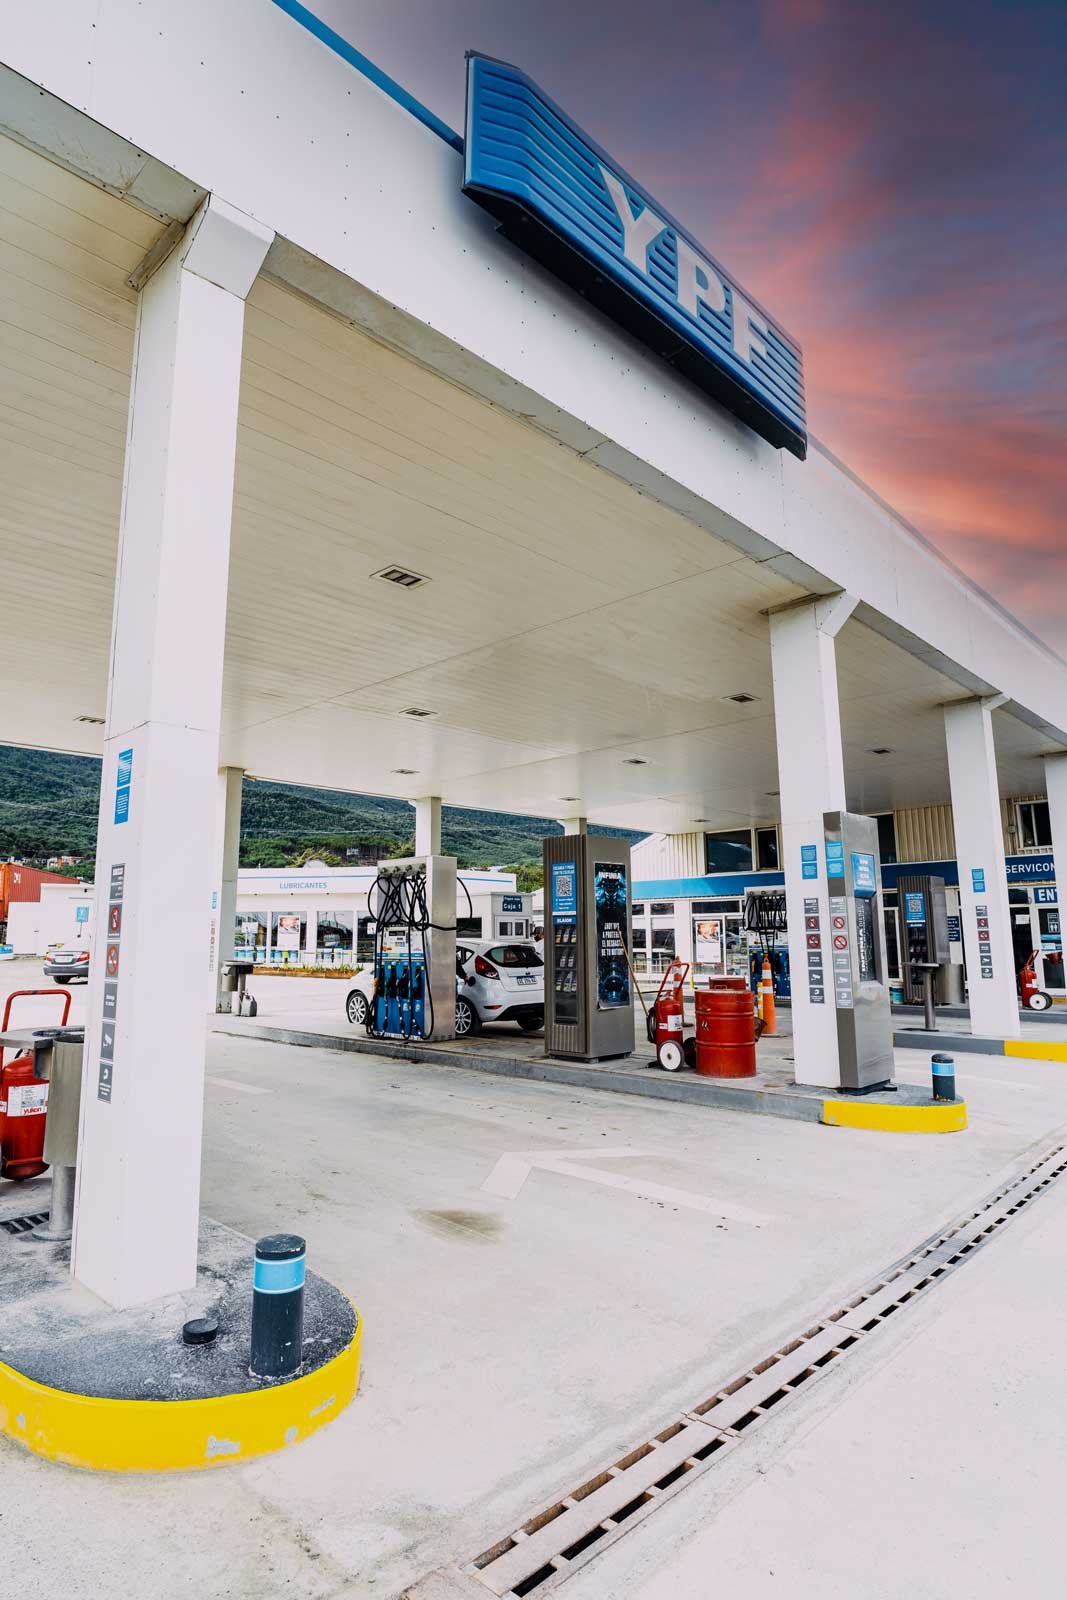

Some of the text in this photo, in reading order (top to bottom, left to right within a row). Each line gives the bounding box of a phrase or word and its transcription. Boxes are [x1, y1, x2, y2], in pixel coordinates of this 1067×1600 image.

[597, 162, 769, 364] YPF
[598, 871, 622, 880] INFINIA
[1038, 888, 1057, 902] EN
